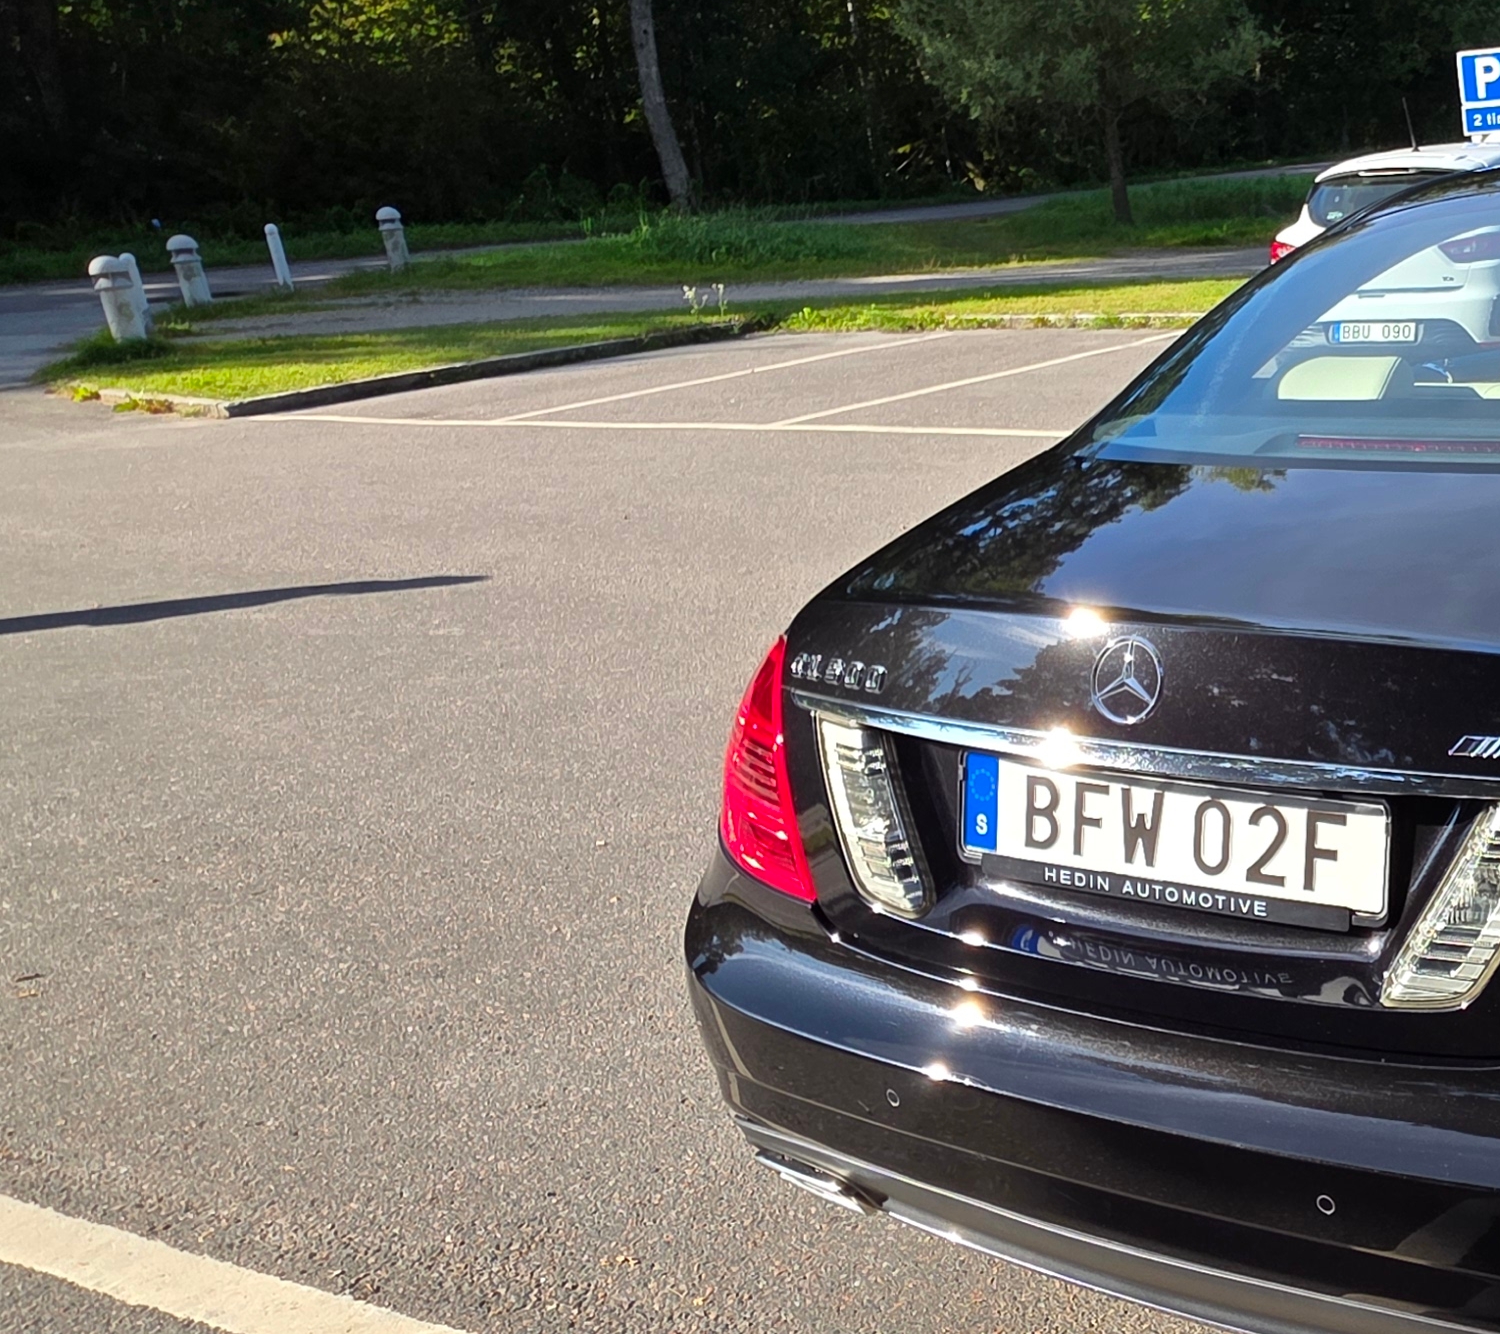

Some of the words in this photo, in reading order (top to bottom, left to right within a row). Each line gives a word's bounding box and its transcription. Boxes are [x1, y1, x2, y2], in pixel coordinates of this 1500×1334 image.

[1473, 113, 1483, 127] 2
[1342, 324, 1371, 340] BBU
[1382, 324, 1412, 340] 090
[975, 813, 988, 835] S
[1024, 774, 1165, 868] BFW
[1193, 798, 1348, 892] 02F
[1044, 867, 1110, 892] HEDIN
[1122, 879, 1268, 917] AUTOMOTIVE
